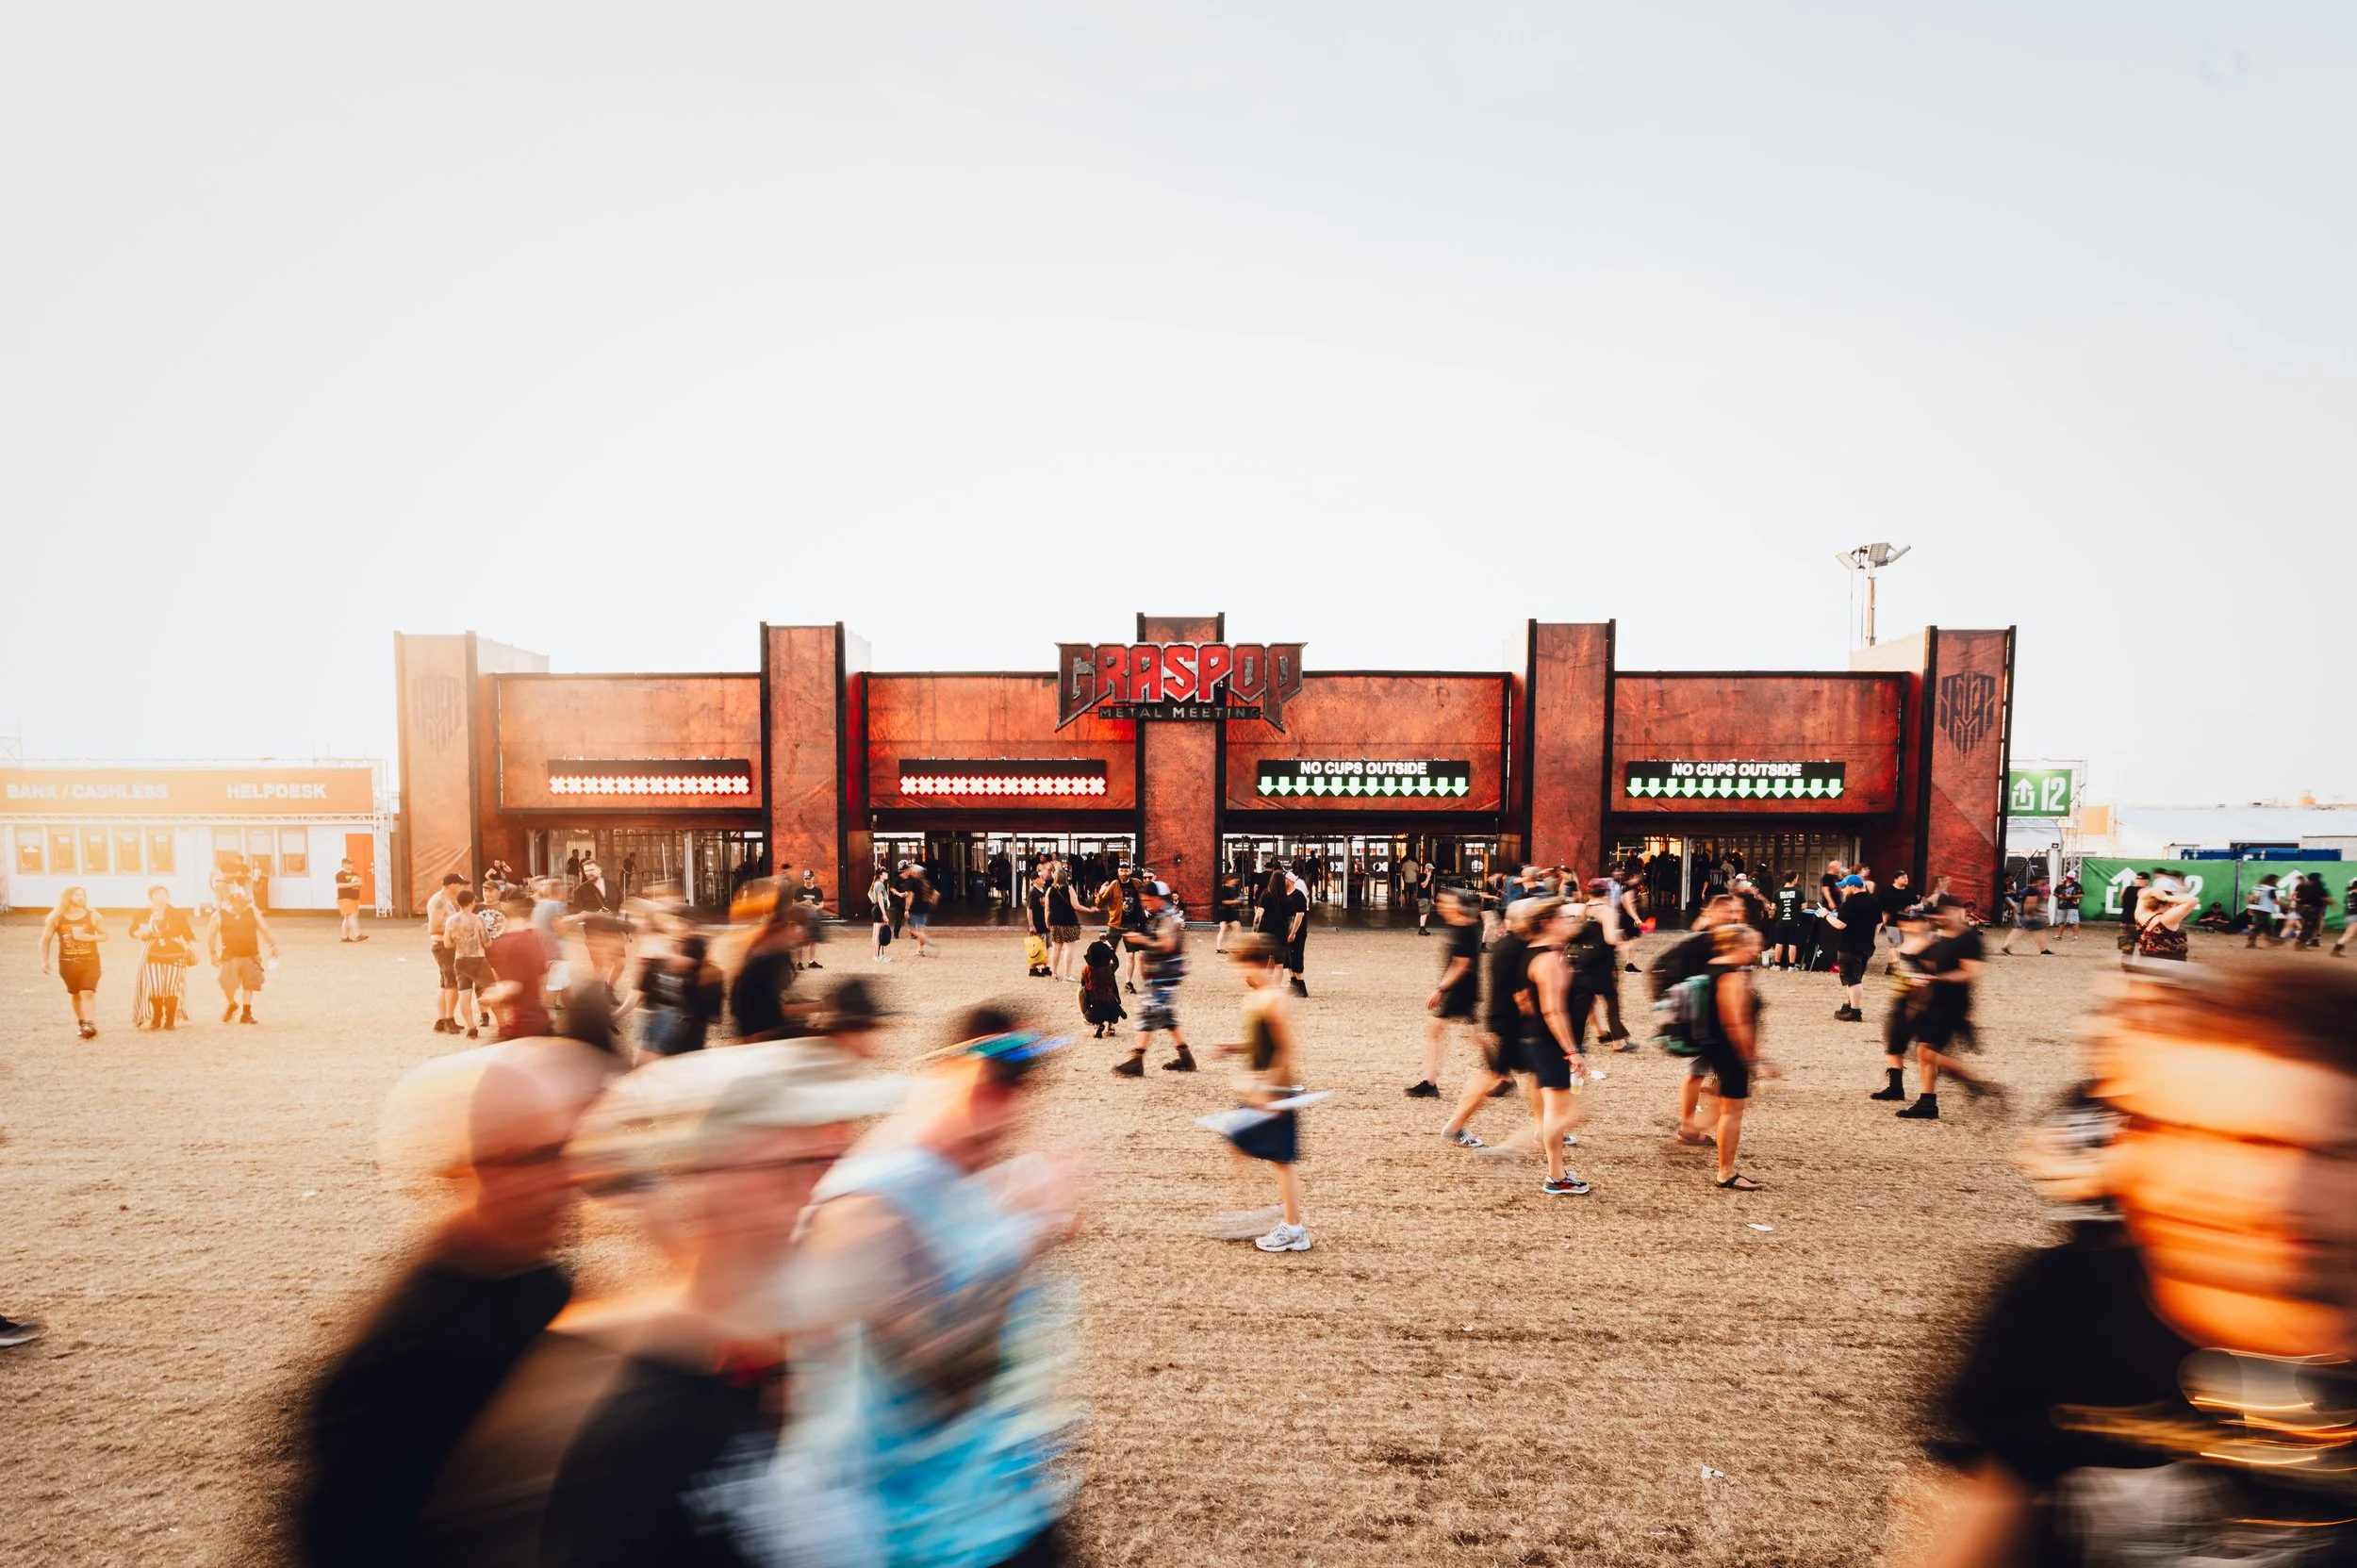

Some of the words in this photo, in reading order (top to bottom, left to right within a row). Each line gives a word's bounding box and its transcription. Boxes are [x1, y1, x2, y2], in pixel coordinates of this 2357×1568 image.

[1055, 642, 1309, 733] GRASPOP
[1099, 708, 1162, 718] METAL
[1173, 707, 1261, 718] MEETING
[1300, 762, 1322, 774] NO
[1325, 762, 1363, 775] CUPS
[1366, 762, 1427, 775] OUTSIDE
[1672, 763, 1693, 776] NO
[1697, 764, 1736, 776] CUPS
[1739, 764, 1802, 777] OUTSIDE
[7, 784, 58, 799] BANK
[72, 784, 169, 799] CASHLESS
[226, 784, 327, 799] HELPDESK
[2041, 777, 2067, 811] 12
